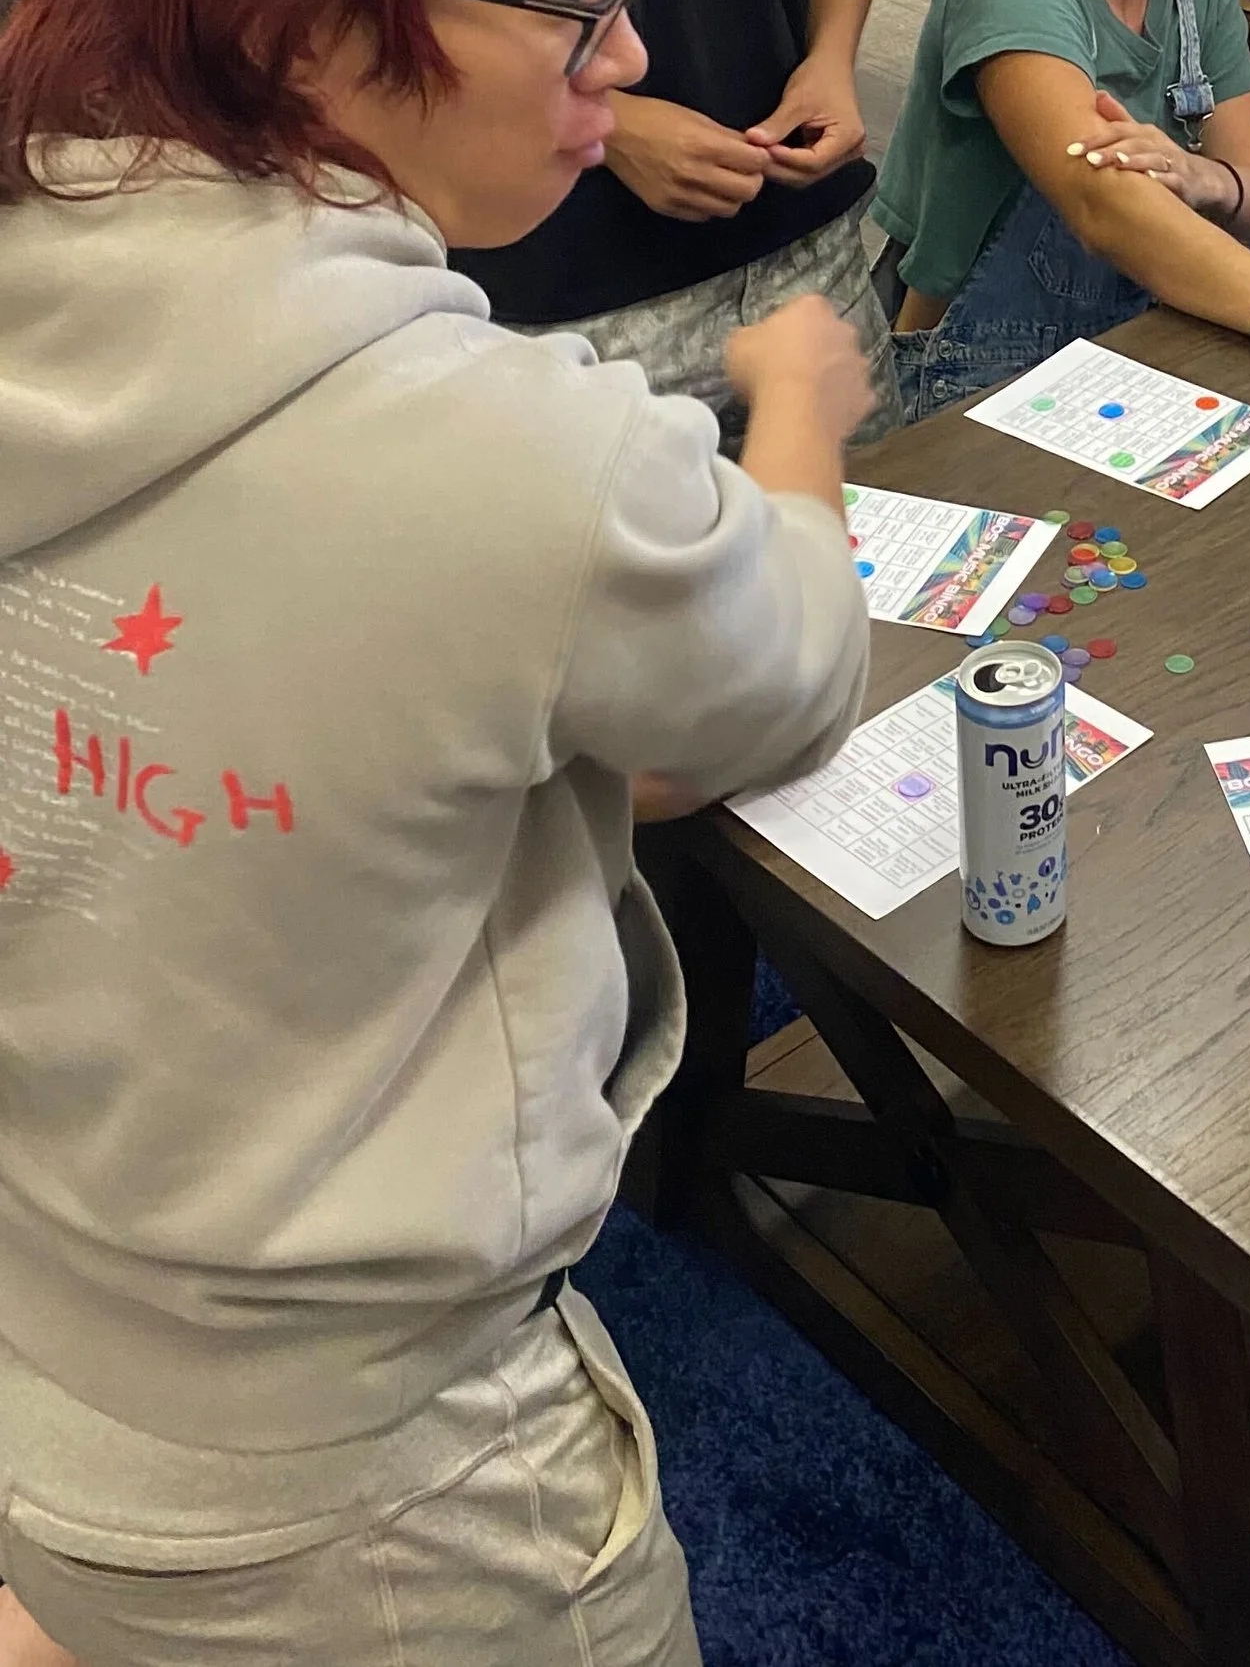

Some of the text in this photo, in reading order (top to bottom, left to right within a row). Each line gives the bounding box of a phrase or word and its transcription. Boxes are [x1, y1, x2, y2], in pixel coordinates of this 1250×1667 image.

[923, 516, 1011, 623] BOS MUSIC BINGO
[53, 708, 295, 848] HIGH
[1065, 735, 1105, 766] NGO
[1016, 786, 1041, 798] MILK
